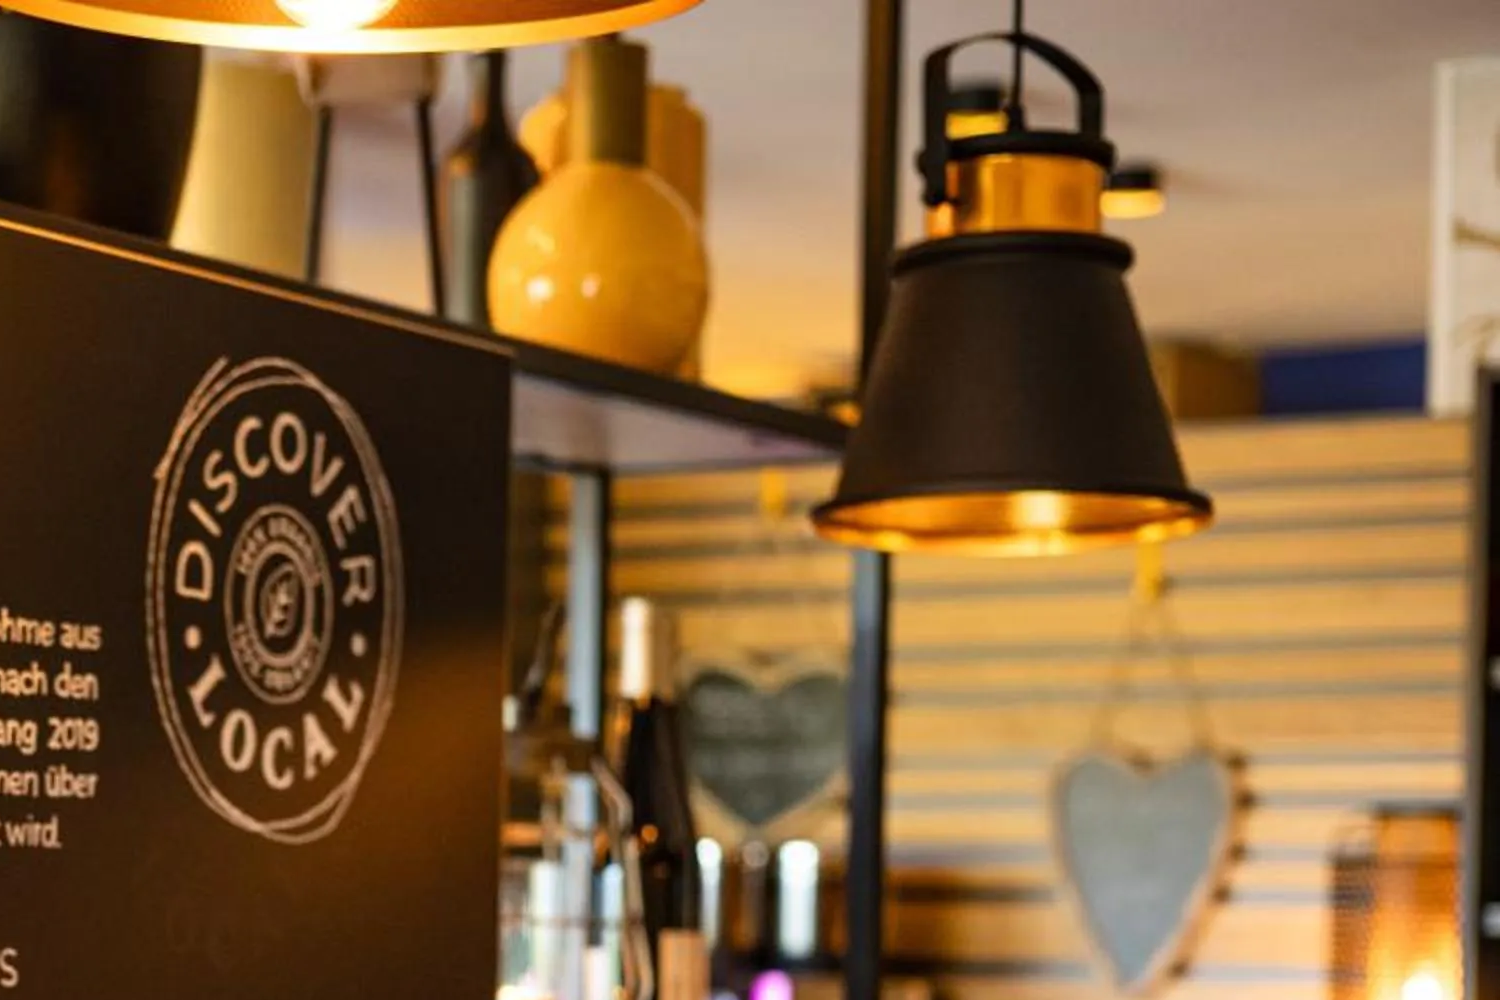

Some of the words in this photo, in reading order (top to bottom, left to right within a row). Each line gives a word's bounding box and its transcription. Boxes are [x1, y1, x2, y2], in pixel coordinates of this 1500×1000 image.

[175, 411, 376, 608] DISCOVER
[60, 622, 101, 650] aus
[54, 661, 99, 700] den
[47, 716, 99, 751] 2019
[188, 655, 364, 790] LOCAL
[44, 764, 98, 798] über
[5, 815, 61, 848] wird.
